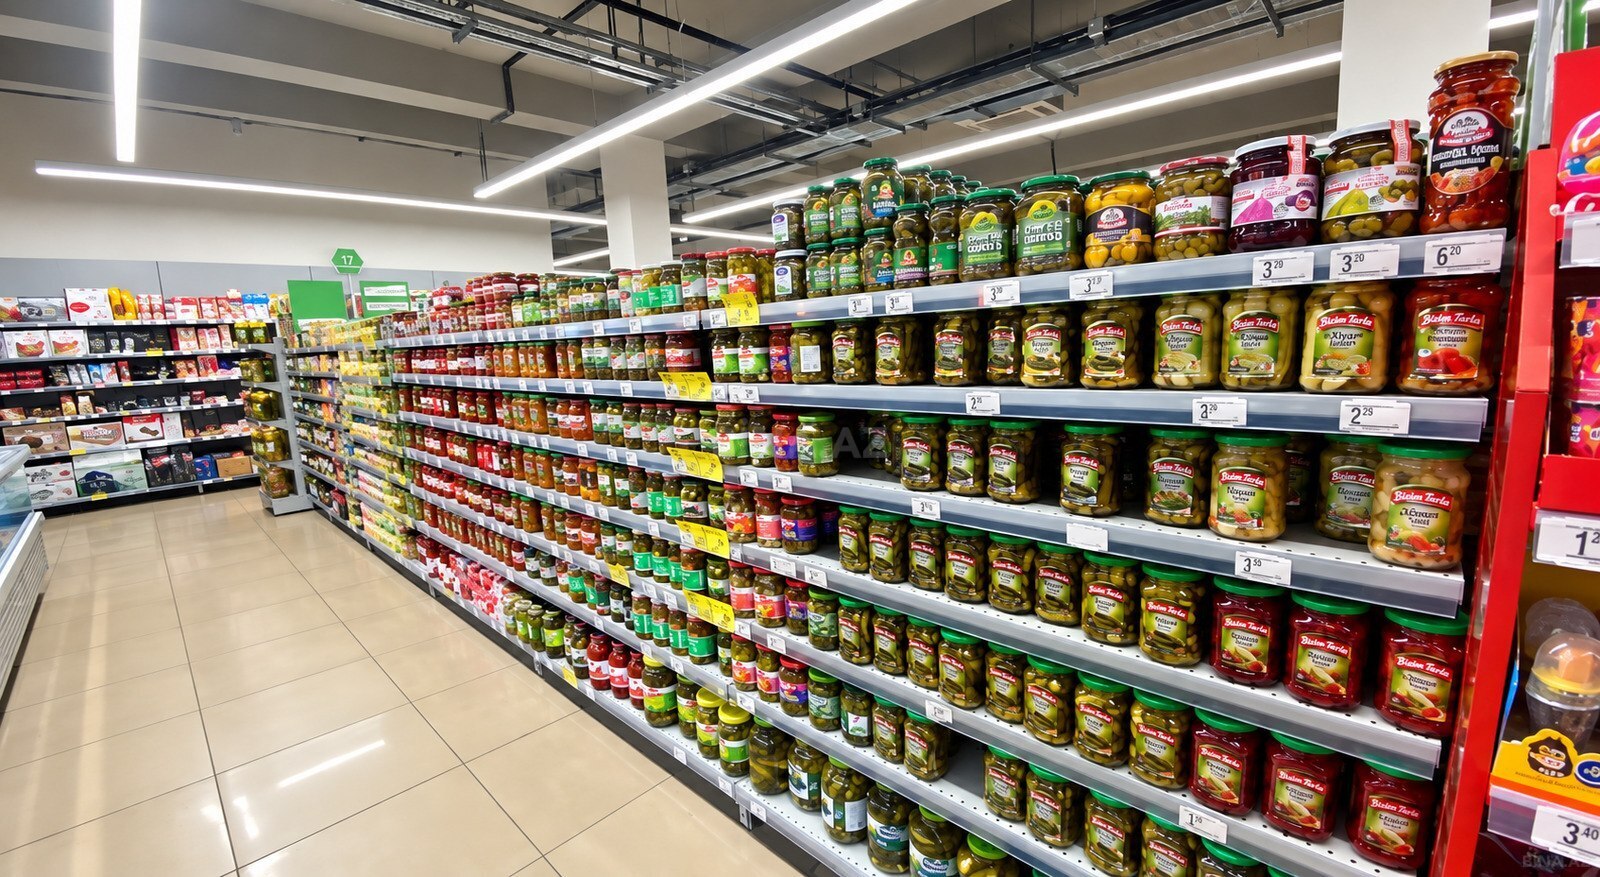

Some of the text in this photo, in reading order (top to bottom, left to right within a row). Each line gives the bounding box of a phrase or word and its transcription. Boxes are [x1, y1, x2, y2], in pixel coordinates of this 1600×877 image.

[341, 255, 354, 266] 17
[1342, 253, 1365, 273] 3 20
[1436, 246, 1461, 266] 6 20
[1262, 261, 1273, 278] 3
[1348, 315, 1373, 326] Tarla
[1454, 313, 1481, 325] Tarla
[1351, 407, 1361, 424] 2
[1243, 474, 1265, 486] Tarla
[1424, 493, 1450, 506] Tarla
[1575, 532, 1587, 555] 1
[1247, 622, 1267, 634] Tarla
[1326, 641, 1349, 656] Tarla
[1425, 662, 1450, 678] Tarla
[1397, 805, 1419, 818] Tarla
[1563, 823, 1599, 845] 3 40
